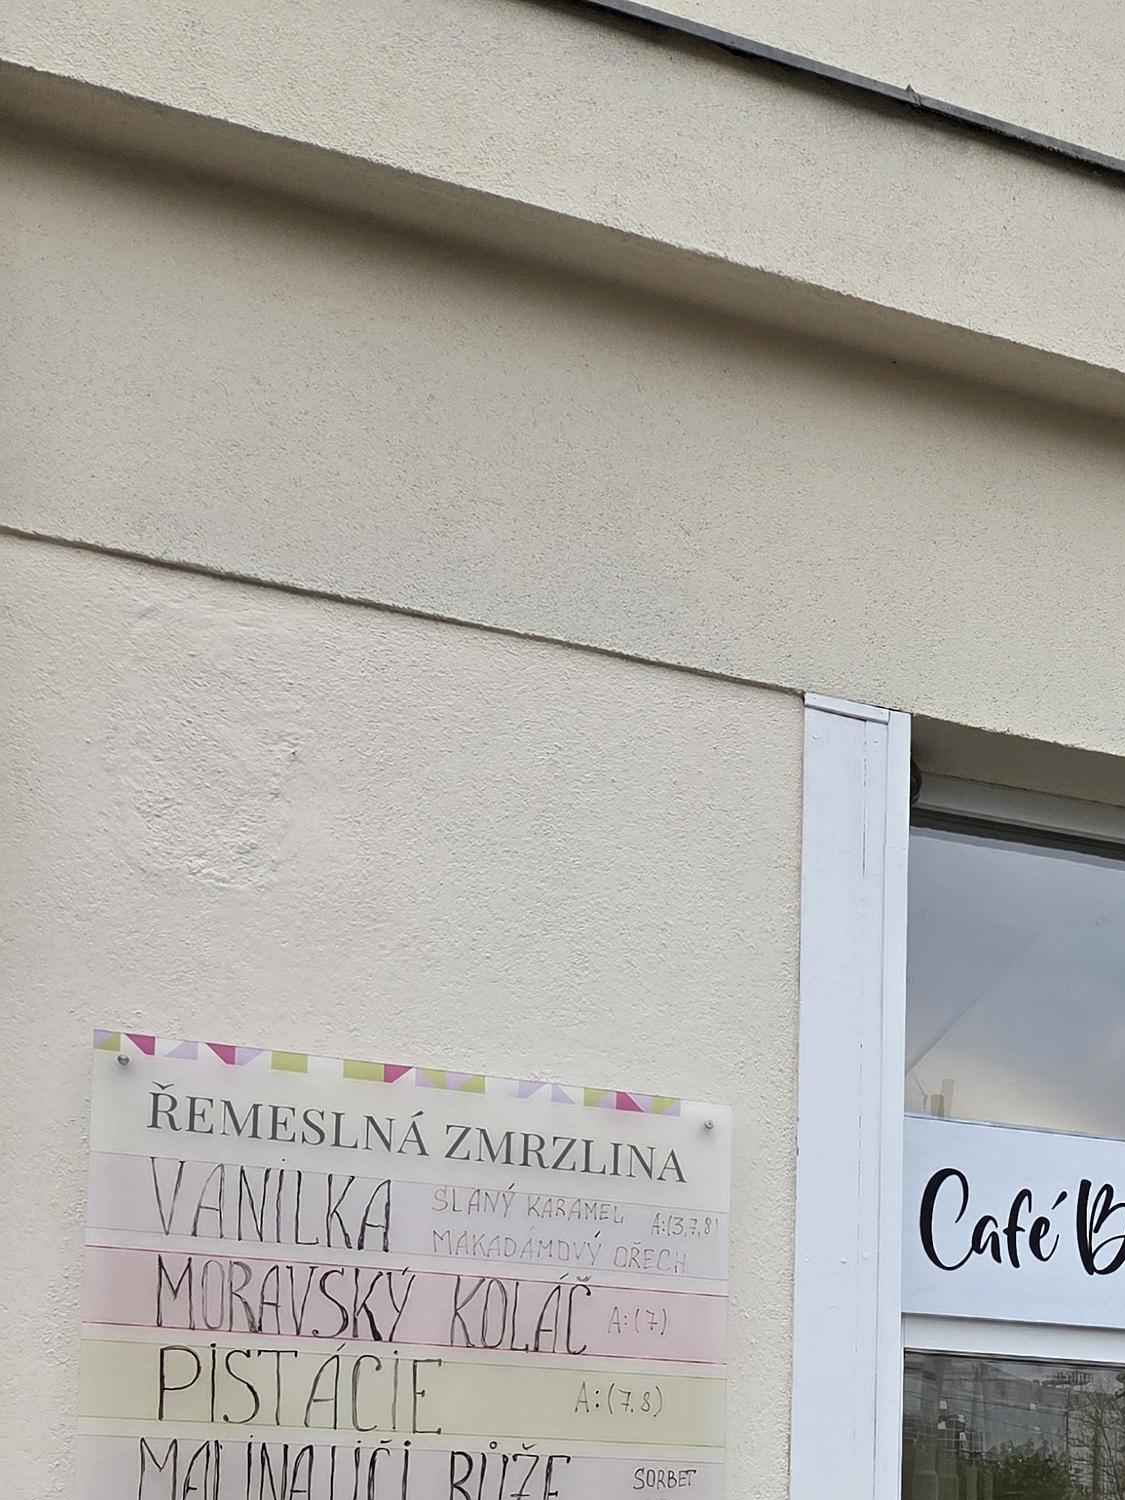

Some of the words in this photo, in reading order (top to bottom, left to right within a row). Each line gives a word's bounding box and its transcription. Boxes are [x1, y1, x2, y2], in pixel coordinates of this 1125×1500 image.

[146, 1081, 431, 1157] ŘEMESLNÁ
[445, 1123, 687, 1183] ZMRZLINA
[150, 1156, 391, 1252] VANILKA
[432, 1183, 516, 1218] SLANÝ
[527, 1195, 625, 1224] KARAMEL
[919, 1167, 1068, 1271] Café
[156, 1253, 416, 1342] MORAVSKÝ
[450, 1273, 592, 1354] KOLÁČ
[614, 1241, 688, 1273] OŘECH
[158, 1343, 443, 1434] PISTÁCIE
[632, 1468, 697, 1490] SORBET
